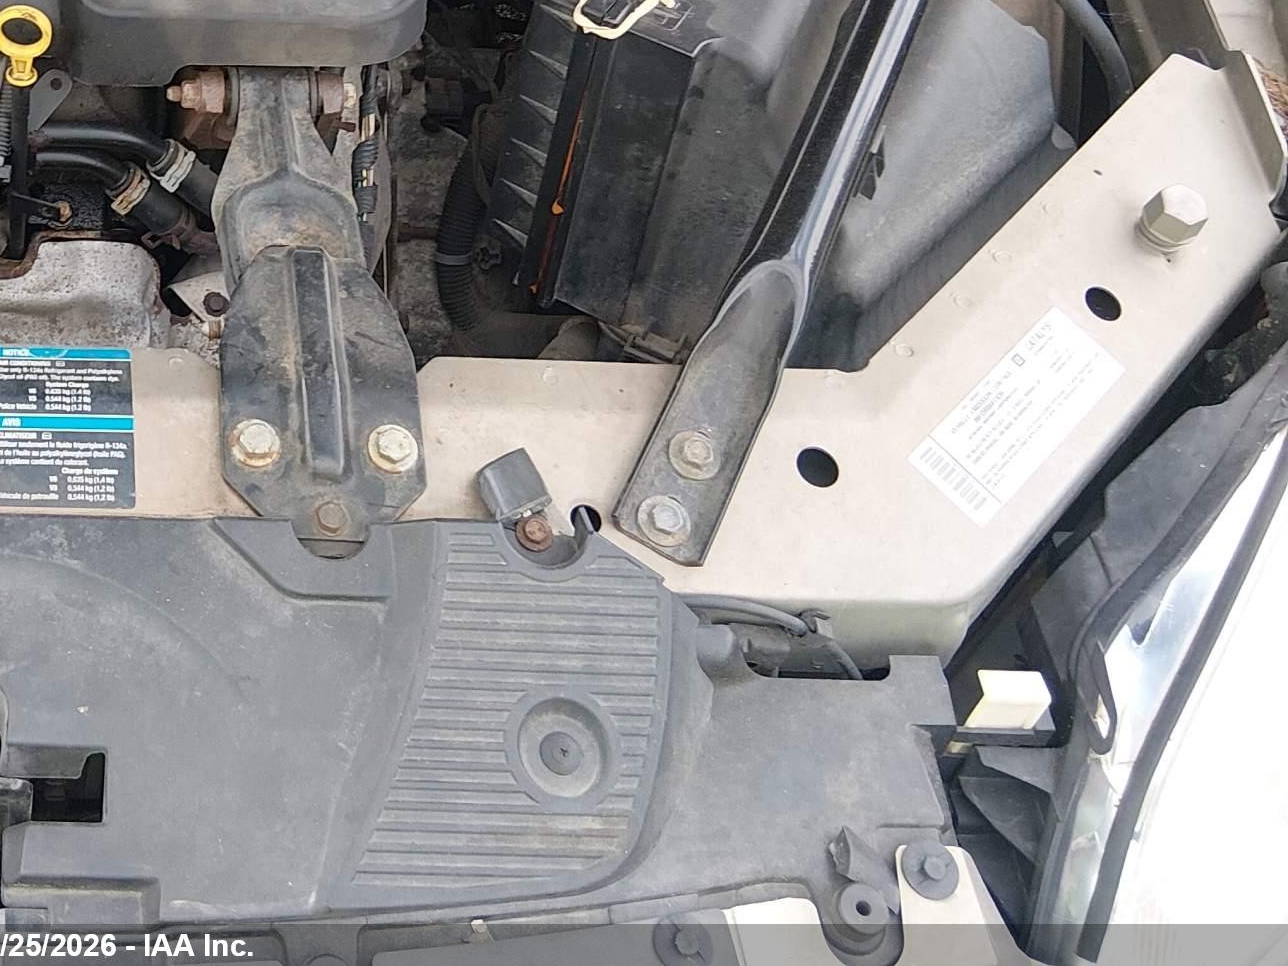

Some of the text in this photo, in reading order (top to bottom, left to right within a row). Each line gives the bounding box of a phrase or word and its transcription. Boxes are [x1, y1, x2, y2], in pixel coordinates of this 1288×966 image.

[2, 418, 22, 427] AVIS
[62, 467, 83, 475] Charge
[84, 476, 93, 484] kg
[84, 485, 93, 493] kg
[84, 493, 93, 502] kg
